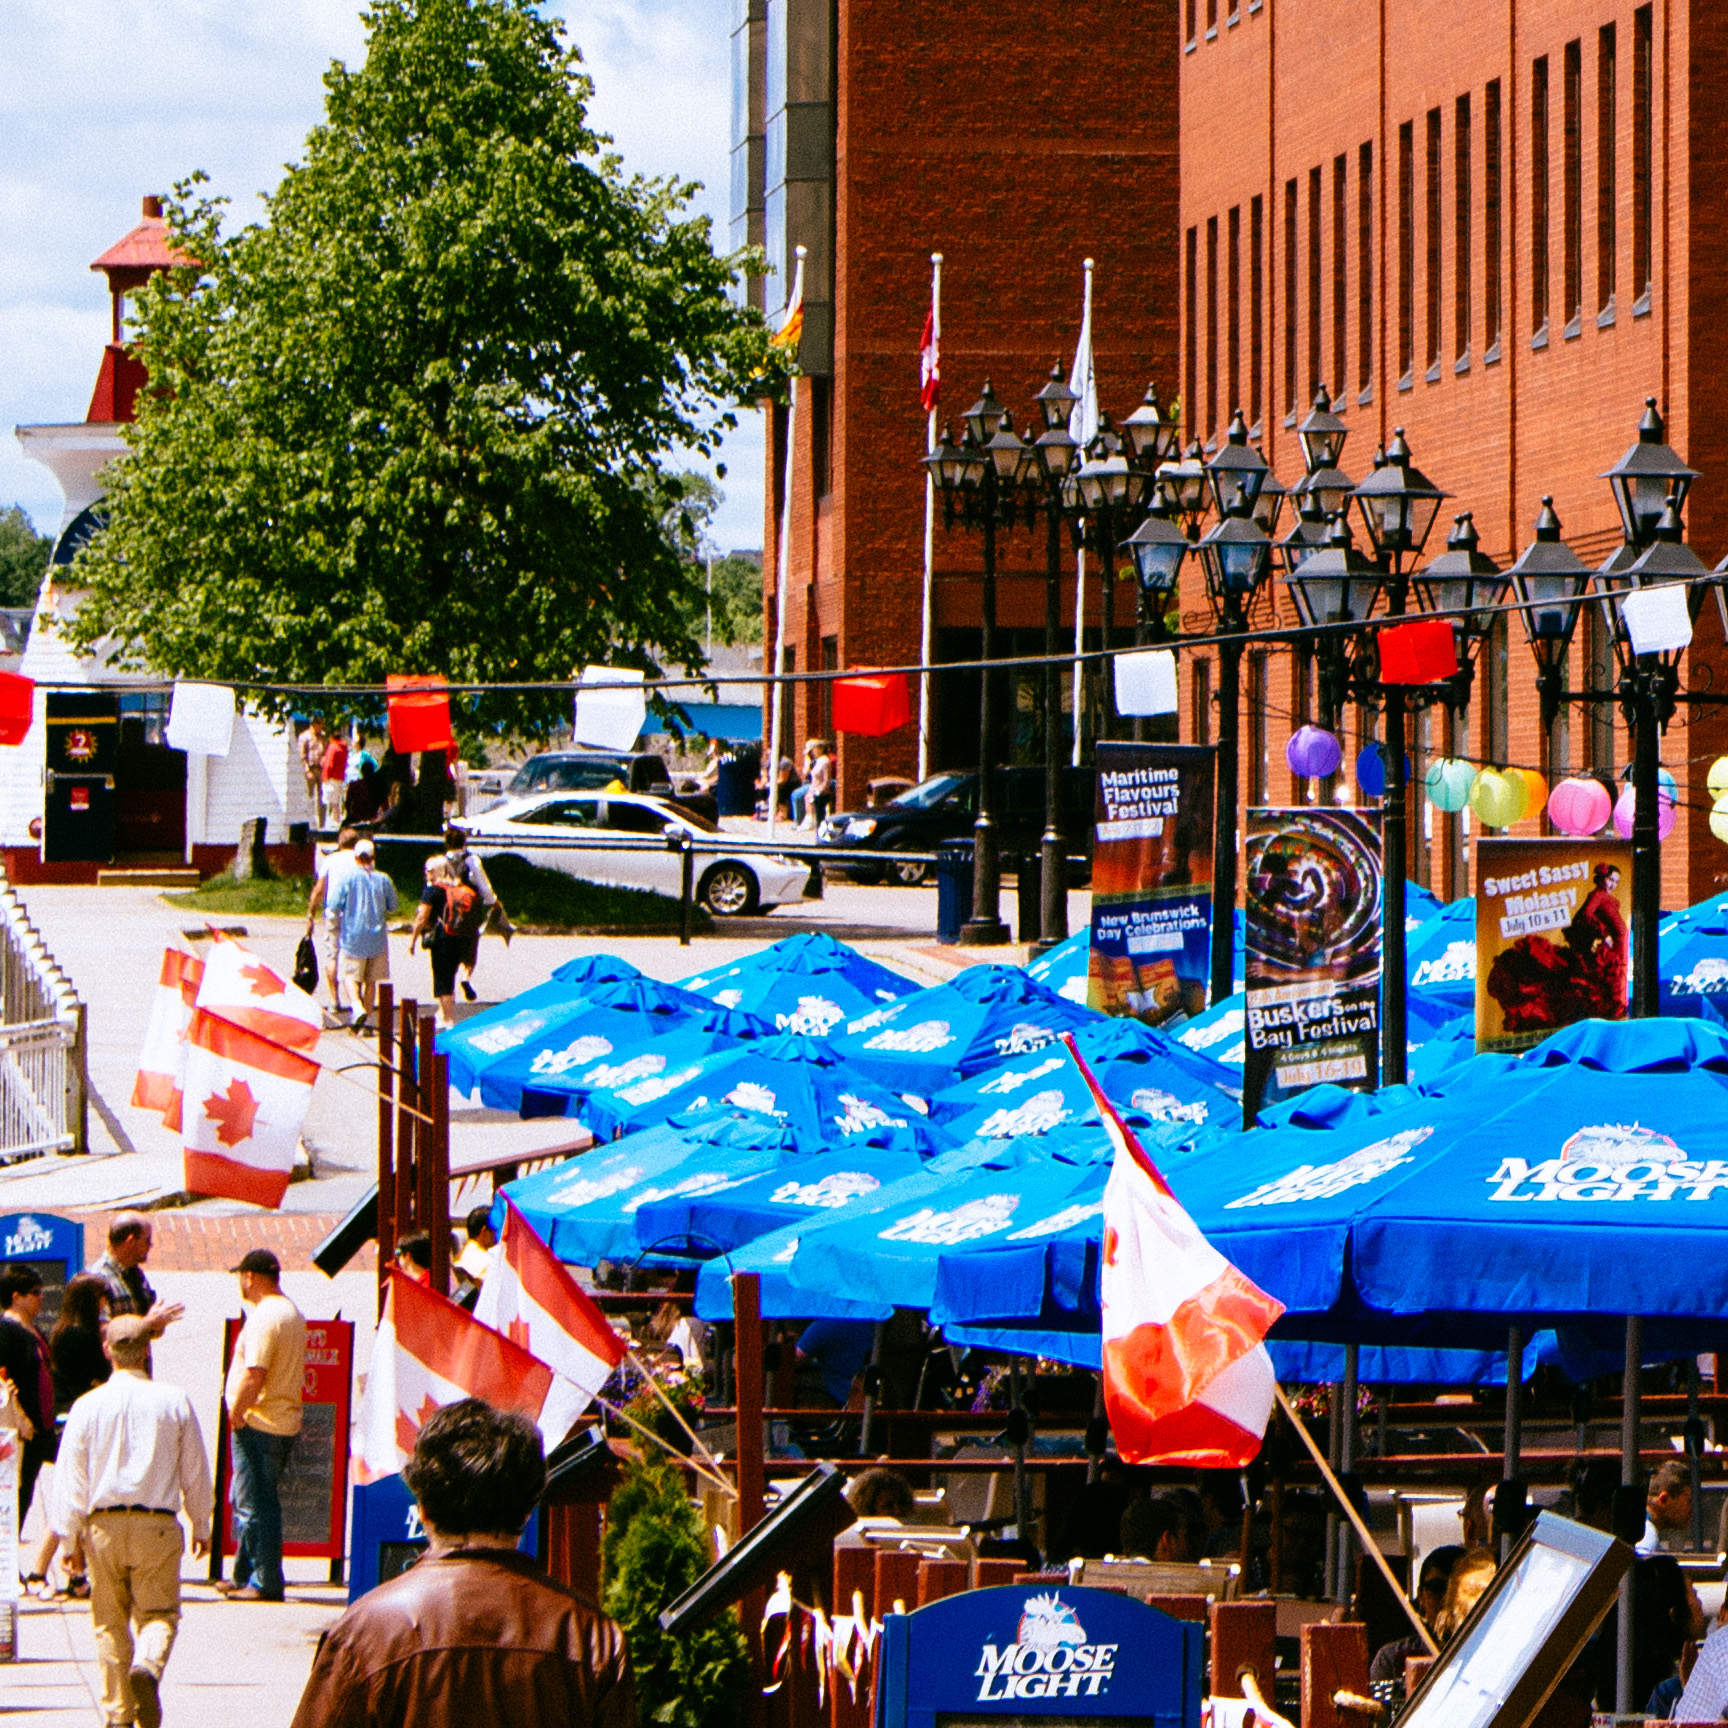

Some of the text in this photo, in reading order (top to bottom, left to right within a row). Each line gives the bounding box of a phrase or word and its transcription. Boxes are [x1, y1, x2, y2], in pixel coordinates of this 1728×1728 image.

[1100, 768, 1179, 788] Maritime
[1103, 783, 1180, 805] Flavours
[1107, 797, 1179, 820] Festival
[1483, 860, 1590, 897] Sweet Sassy
[1504, 887, 1577, 917] Molassy
[1096, 916, 1208, 941] Day Celebrations
[1100, 903, 1199, 929] New Brunswick
[1504, 916, 1526, 933] July
[1528, 914, 1543, 927] 10
[1553, 908, 1566, 922] 11
[1247, 998, 1345, 1029] Buskers
[1344, 1003, 1358, 1013] on
[1251, 1028, 1293, 1049] Bay
[1298, 1009, 1377, 1042] Festival
[1283, 1060, 1362, 1086] July 16-19
[974, 1643, 1119, 1677] MOOSE
[976, 1671, 1113, 1702] LIGHT
